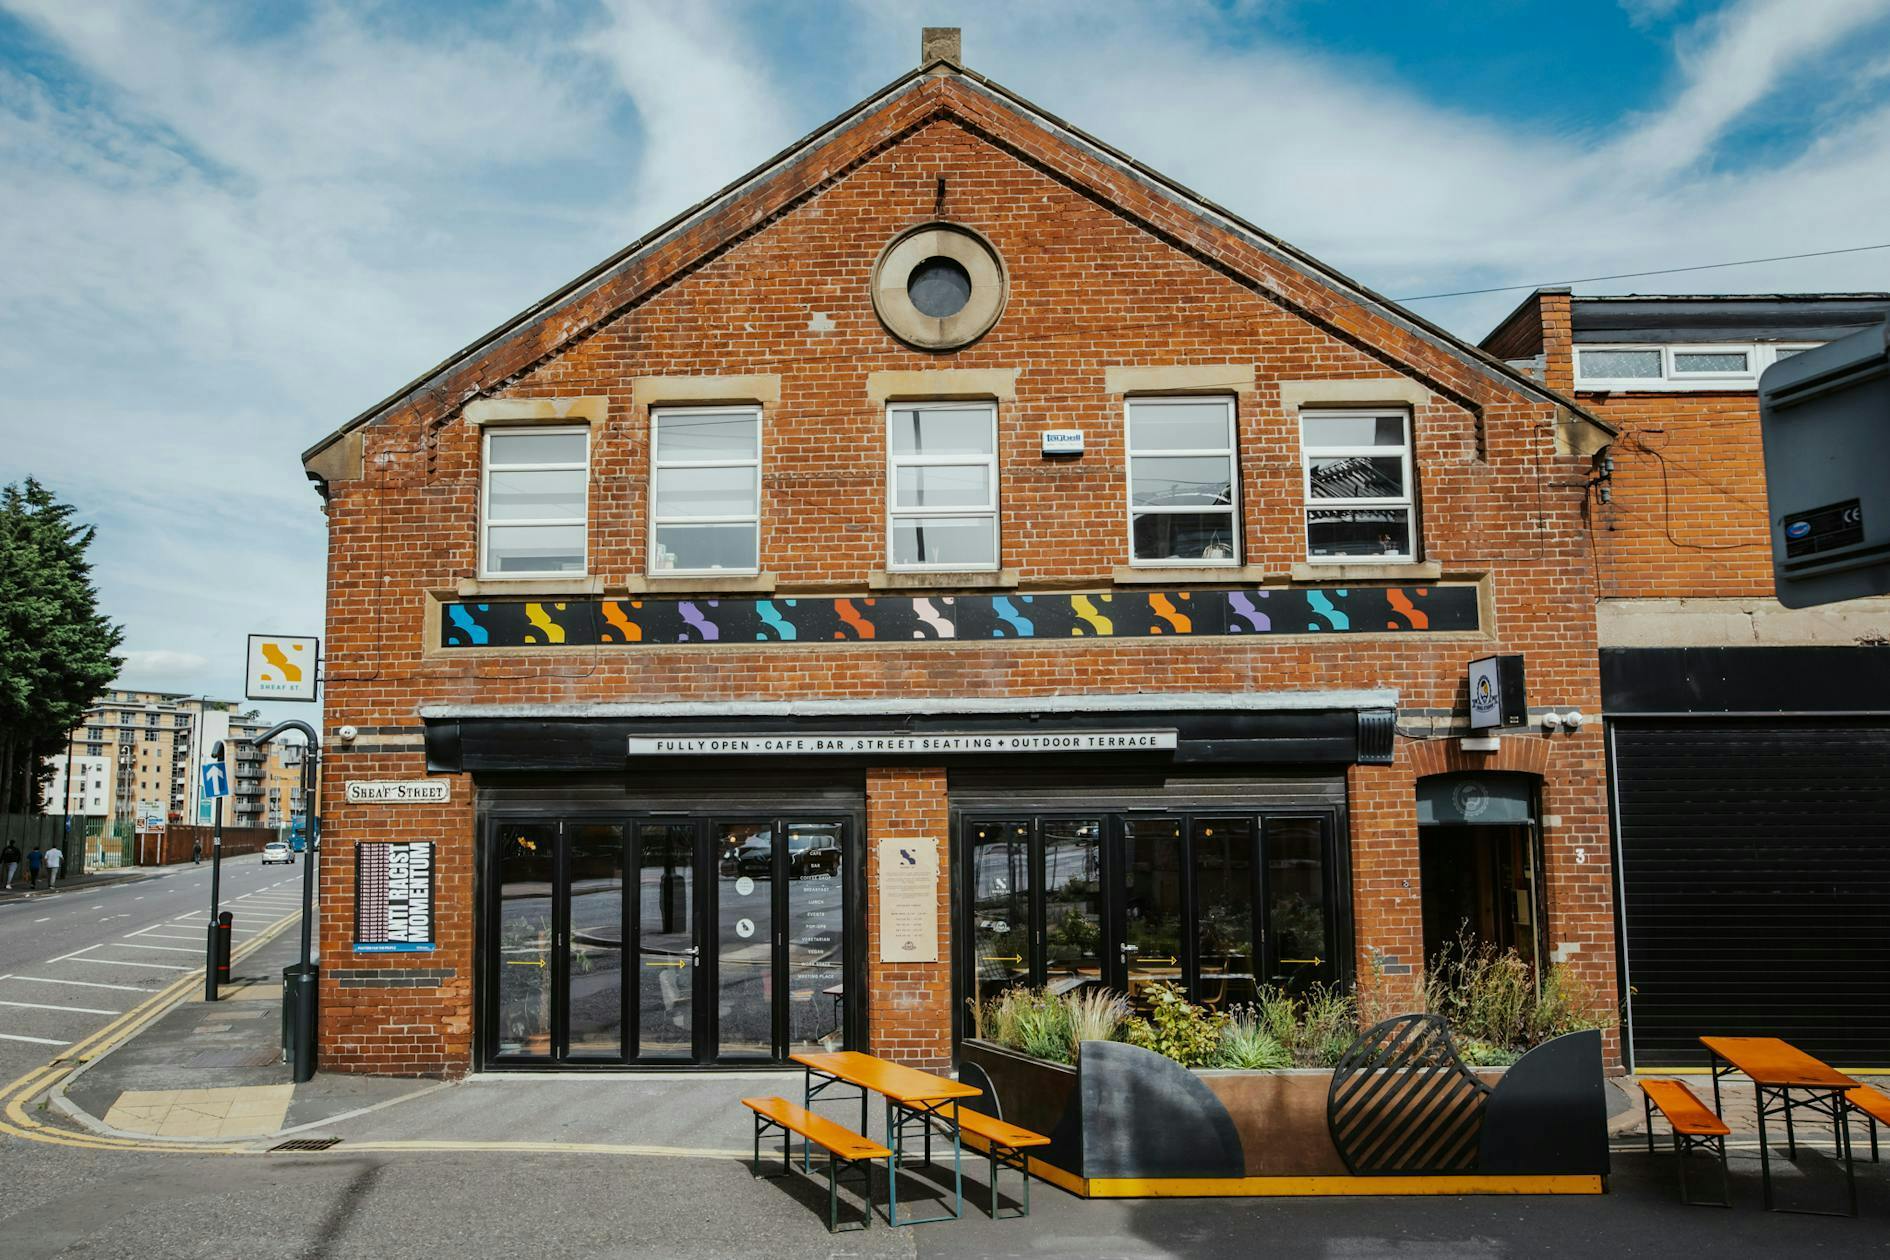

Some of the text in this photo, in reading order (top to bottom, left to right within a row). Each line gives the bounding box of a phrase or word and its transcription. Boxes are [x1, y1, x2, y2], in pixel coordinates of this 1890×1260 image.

[657, 741, 705, 750] FULLY
[711, 741, 749, 750] OPEN
[923, 739, 992, 749] SEATING
[1011, 738, 1080, 748] OUTDOOR
[1088, 736, 1157, 747] TERRACE
[352, 785, 443, 798] SHEAF STREET
[1575, 847, 1585, 864] 3
[388, 844, 410, 941] ANTI RACIST
[408, 842, 430, 942] MOMENTUM
